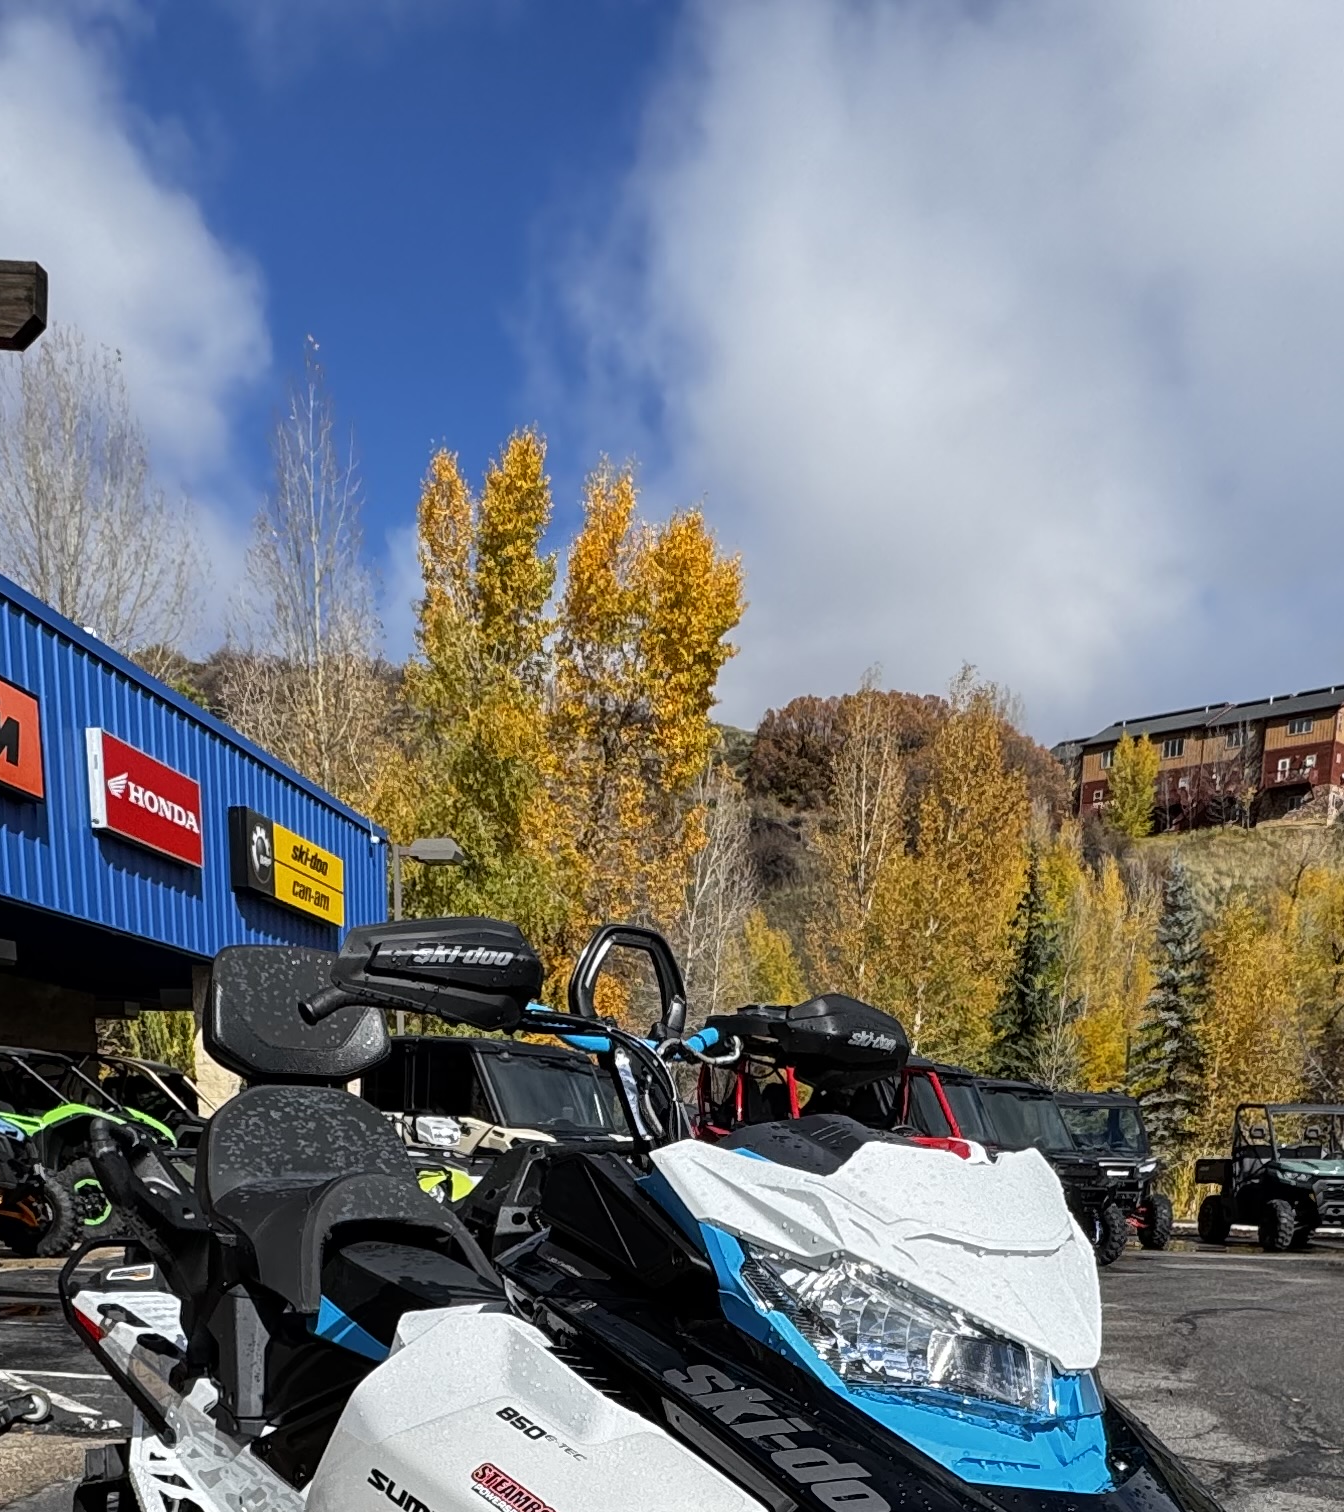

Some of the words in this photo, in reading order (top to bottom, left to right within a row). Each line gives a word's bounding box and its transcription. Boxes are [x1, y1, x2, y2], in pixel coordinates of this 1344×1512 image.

[127, 780, 201, 834] HONDA
[290, 844, 329, 877] ski-doo
[291, 880, 330, 912] can-am
[412, 945, 515, 966] ski-doo
[495, 1406, 548, 1441] 850
